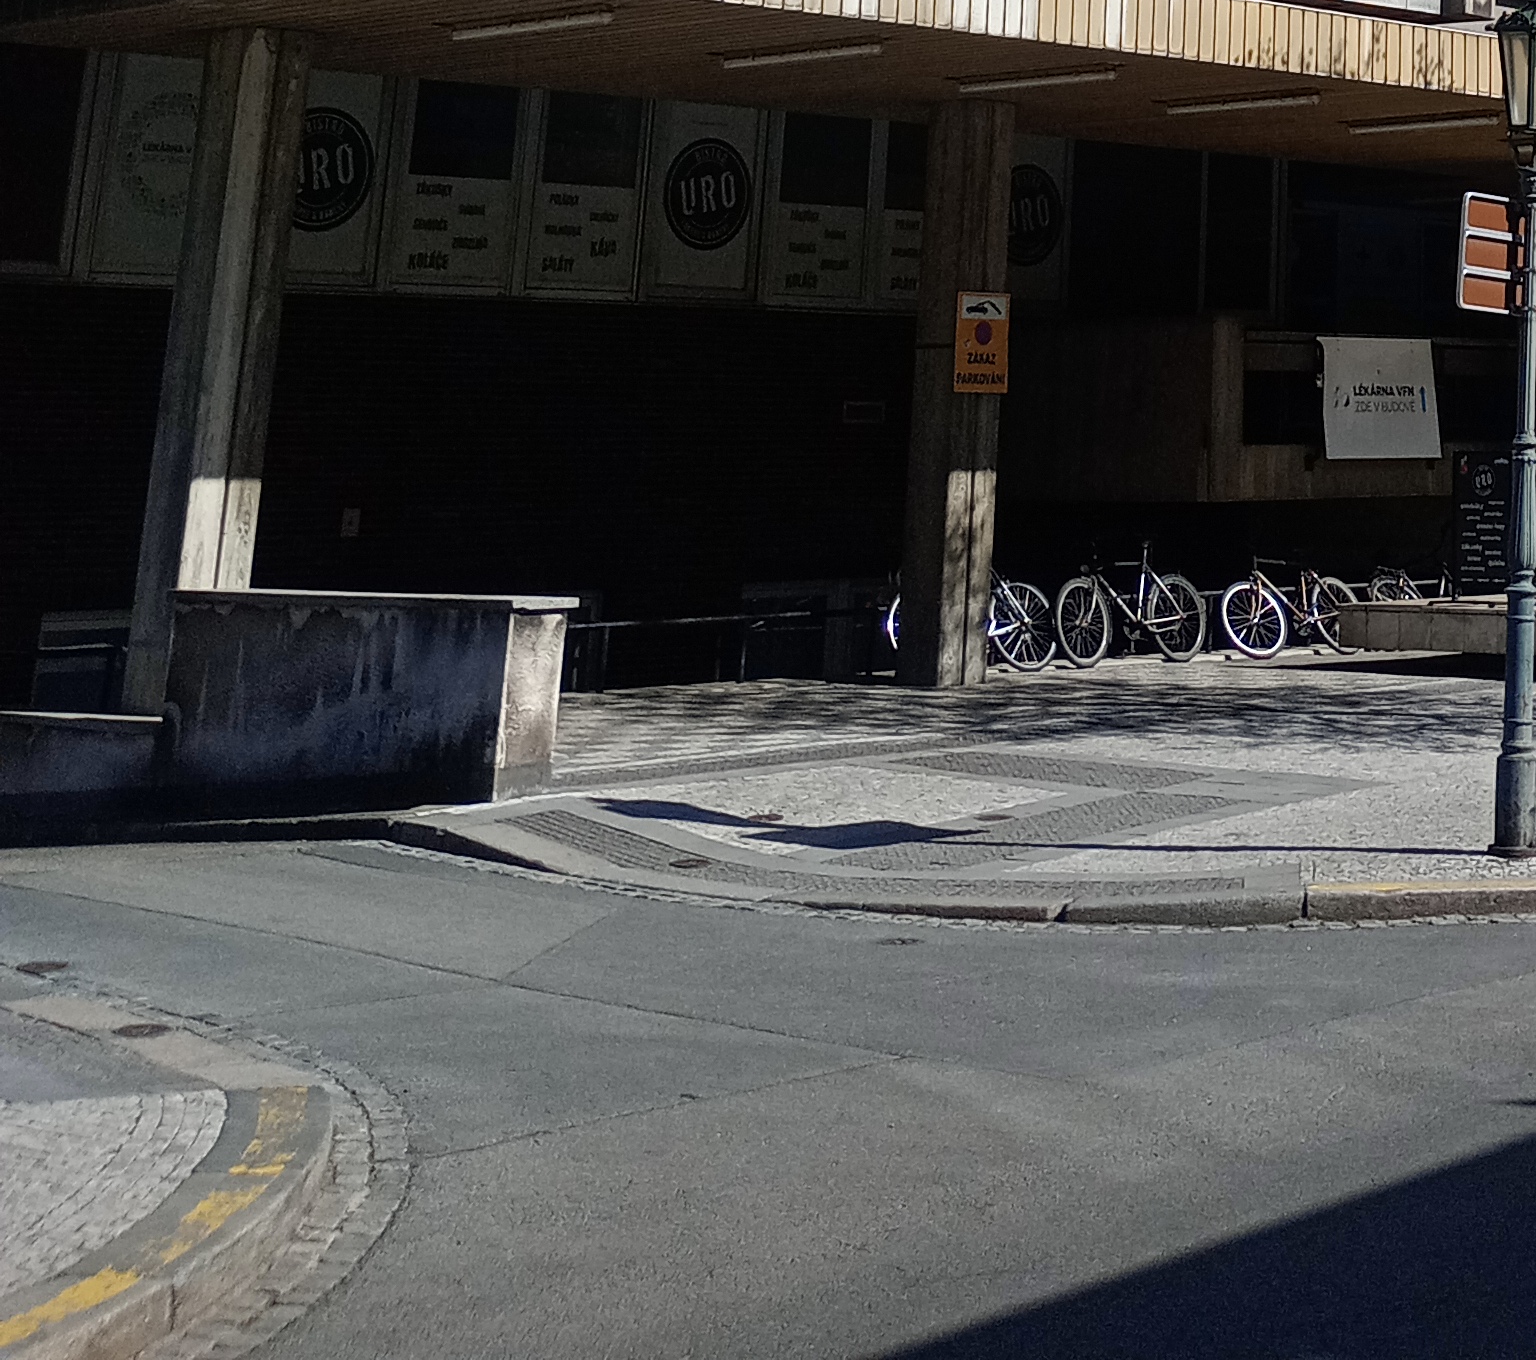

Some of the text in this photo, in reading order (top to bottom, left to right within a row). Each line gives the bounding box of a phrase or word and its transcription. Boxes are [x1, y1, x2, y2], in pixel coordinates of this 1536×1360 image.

[679, 170, 736, 216] URO
[967, 351, 997, 365] ZÁKAZ
[1353, 382, 1395, 397] LÉKÁRNA
[1355, 400, 1373, 413] ZDE
[1373, 400, 1380, 413] V
